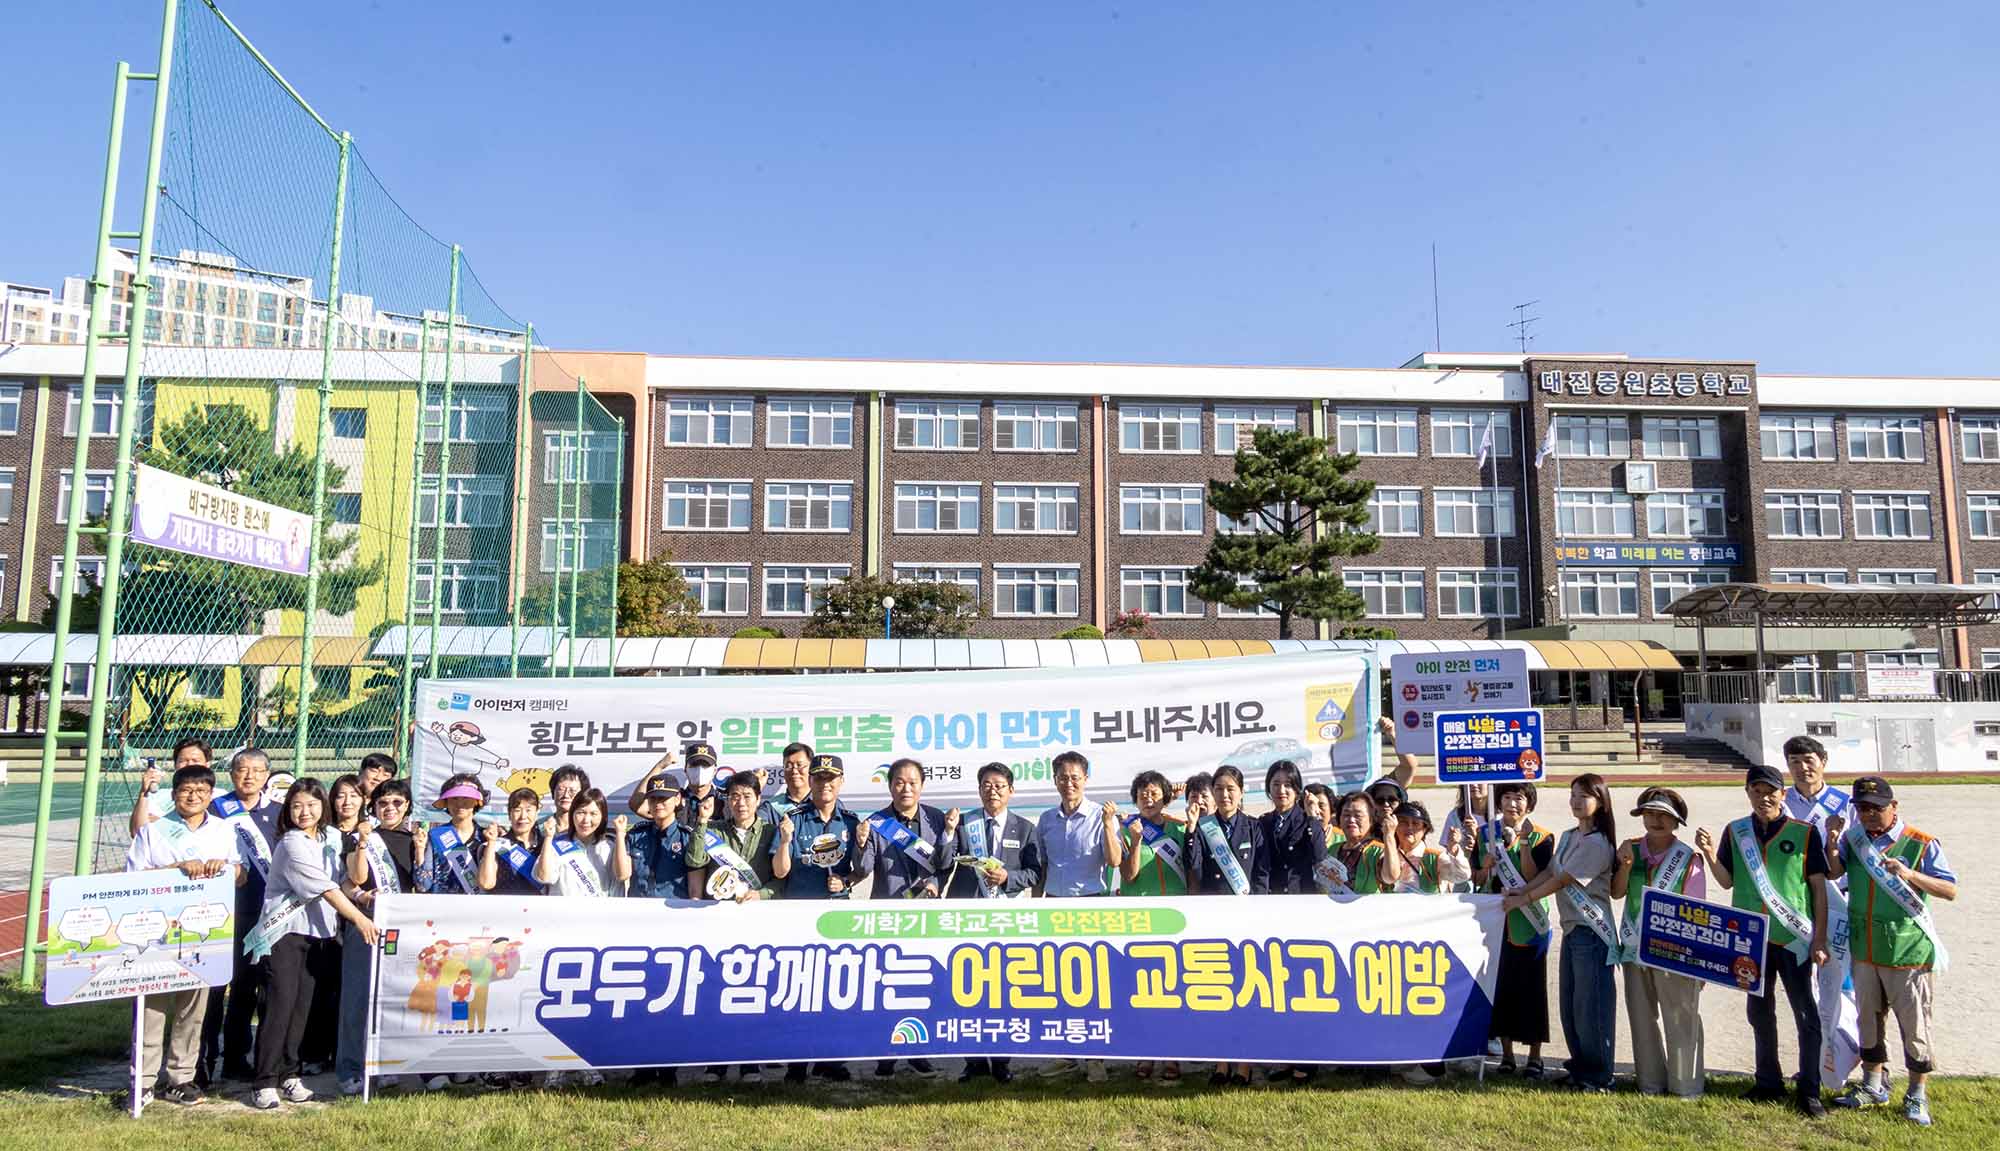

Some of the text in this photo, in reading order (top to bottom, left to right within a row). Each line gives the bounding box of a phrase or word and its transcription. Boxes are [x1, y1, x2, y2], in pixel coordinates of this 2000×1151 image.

[1541, 370, 1751, 395] 대전중원초등학교
[244, 506, 271, 534] 펜스에
[1594, 547, 1617, 560] 학교
[1621, 547, 1657, 560] 미래를
[1662, 547, 1685, 560] 여는
[1689, 547, 1737, 560] 중원교육
[1416, 658, 1500, 674] 아이 안전 먼저
[474, 699, 568, 711] 아이먼저 캠페인
[528, 720, 668, 757] 횡단보도
[721, 718, 801, 755] 일단
[814, 714, 895, 753] 멈춤
[906, 713, 987, 750] 아이
[1001, 709, 1081, 749] 먼저
[1090, 701, 1276, 745] 보내주세요.
[1443, 719, 1506, 734] 매월 4일은
[1444, 732, 1533, 750] 안전점검의 날
[922, 765, 962, 781] 덕구청
[99, 890, 131, 900] 안전하게
[132, 888, 148, 896] 타기
[150, 885, 172, 895] 3단계
[851, 909, 1153, 935] 개학기 학교주변 안전점검
[1651, 899, 1723, 929] 매월 4일은
[1650, 914, 1731, 949] 안전점검의
[1734, 934, 1753, 954] 날
[540, 942, 1452, 1019] 모두가 함께하는 어린이 교통사고 예방
[936, 1018, 1112, 1045] 대덕구청 교통과
